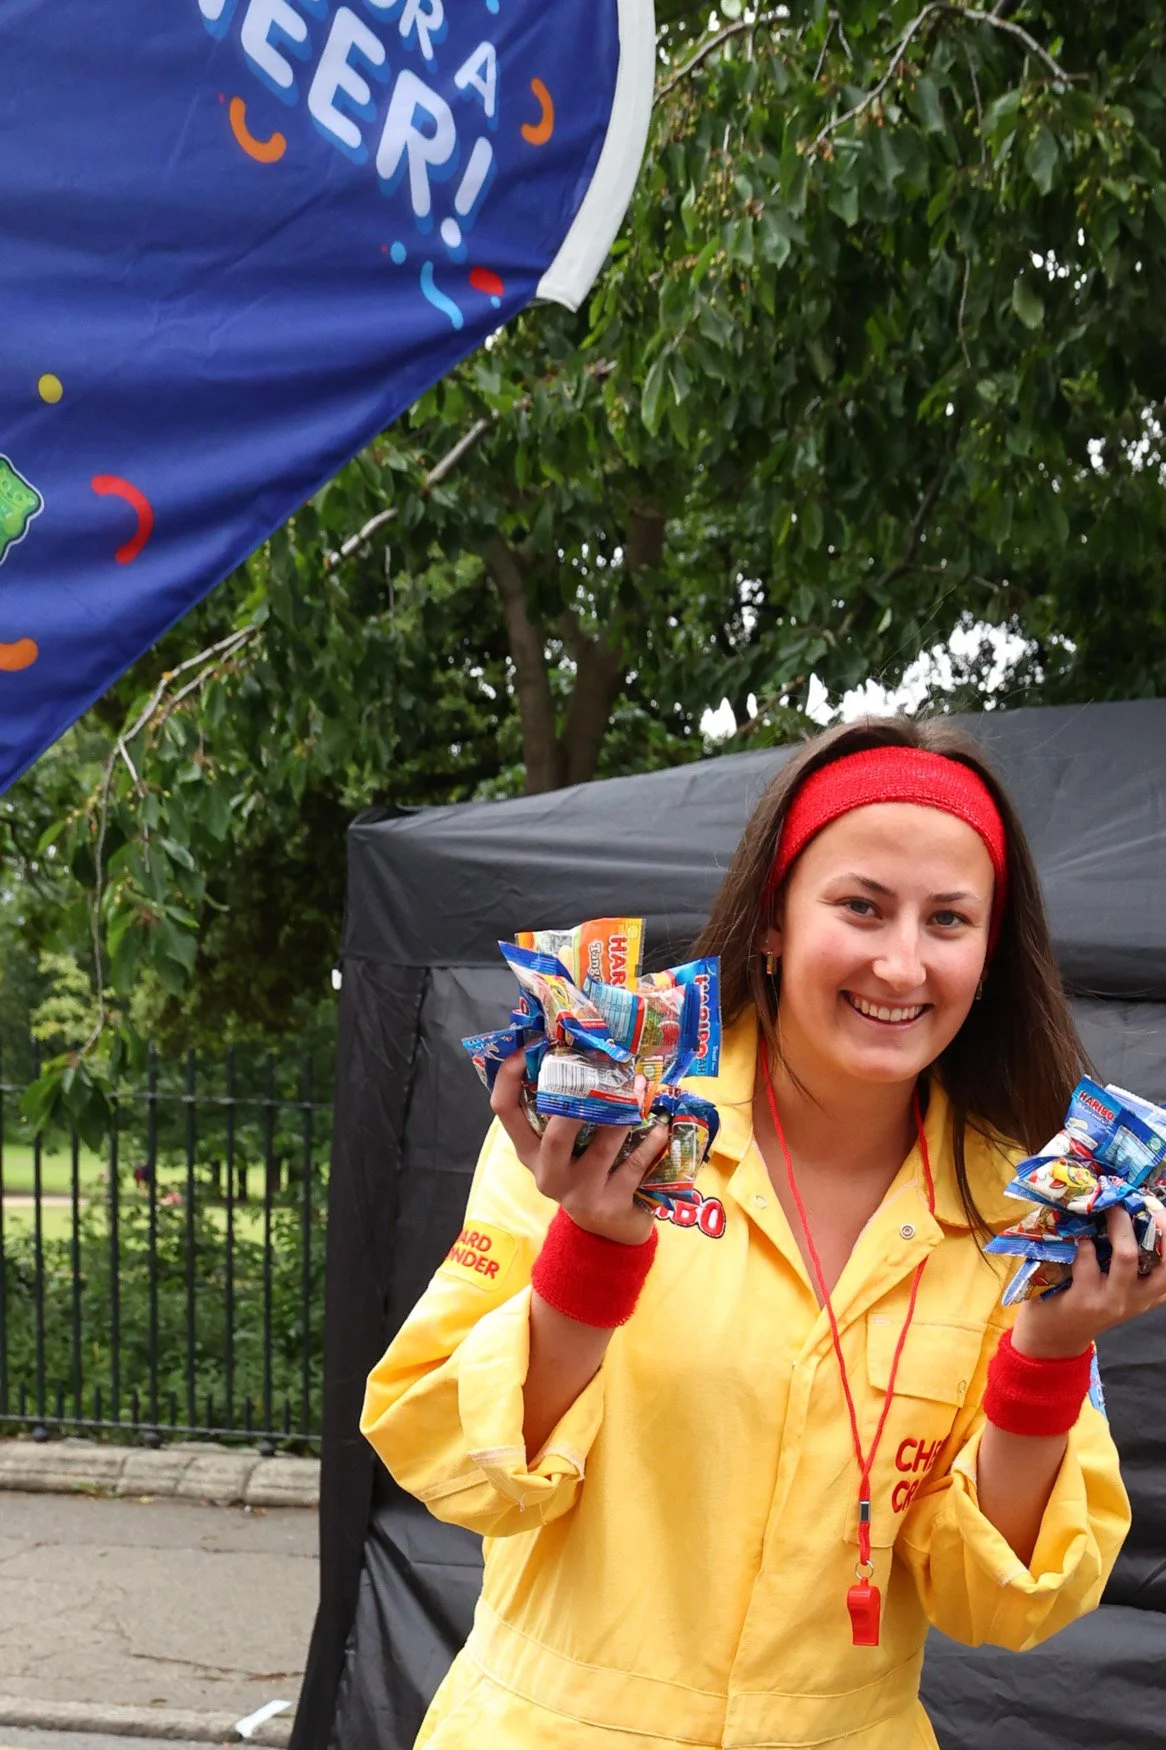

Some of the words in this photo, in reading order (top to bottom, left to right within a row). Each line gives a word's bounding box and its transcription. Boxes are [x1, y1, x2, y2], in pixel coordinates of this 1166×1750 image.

[453, 41, 498, 122] A
[199, 0, 494, 250] EER!
[608, 933, 628, 991] HAR
[1079, 1090, 1116, 1122] HARIBO
[446, 1246, 500, 1280] NDER
[895, 1438, 943, 1473] CH
